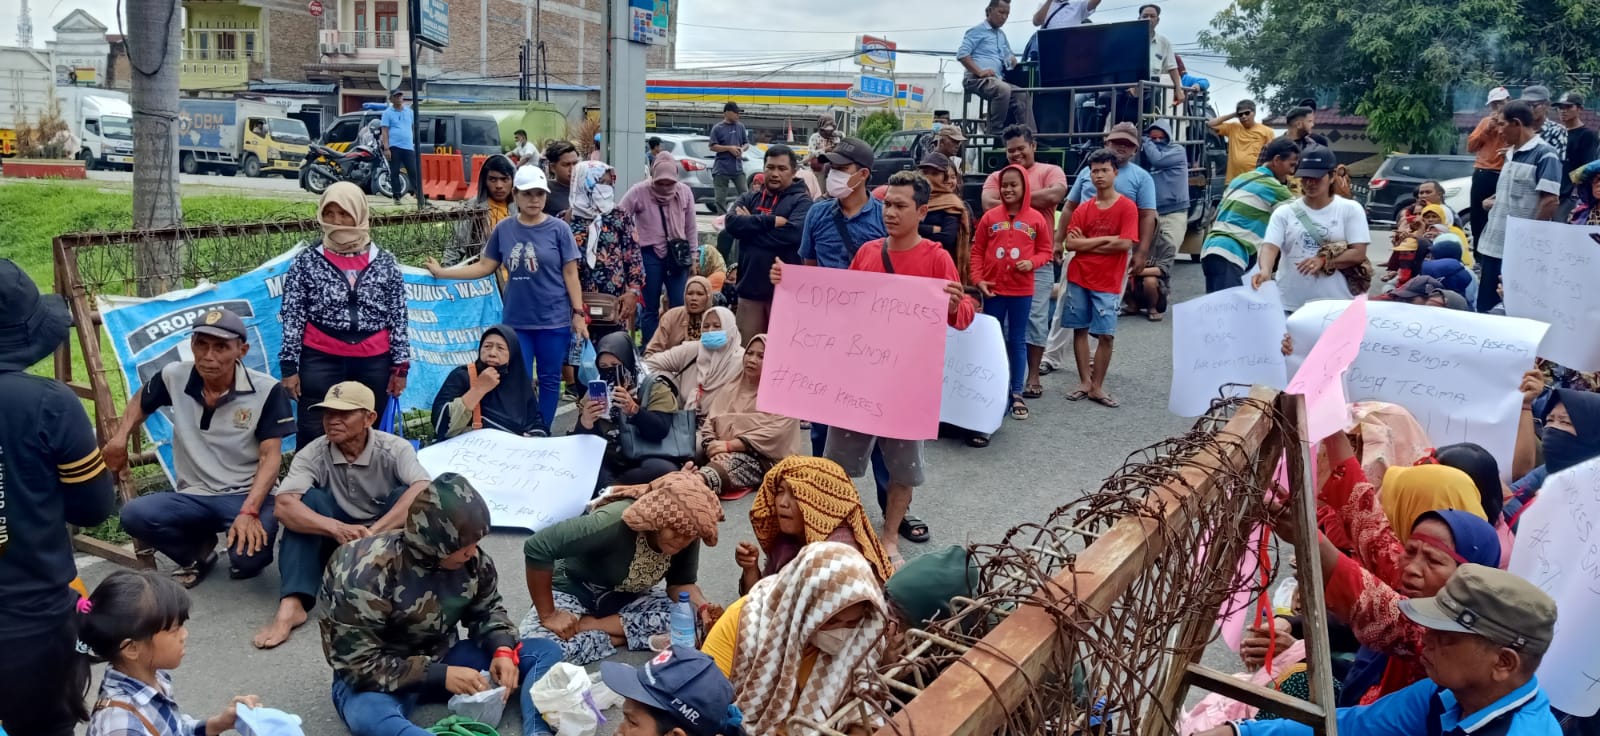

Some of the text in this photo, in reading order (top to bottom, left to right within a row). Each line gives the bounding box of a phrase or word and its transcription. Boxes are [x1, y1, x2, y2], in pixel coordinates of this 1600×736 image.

[193, 113, 224, 129] DBM
[790, 320, 899, 369] KOTA BINJAI
[1359, 341, 1401, 357] OLRES
[1395, 379, 1468, 404] TERIMA
